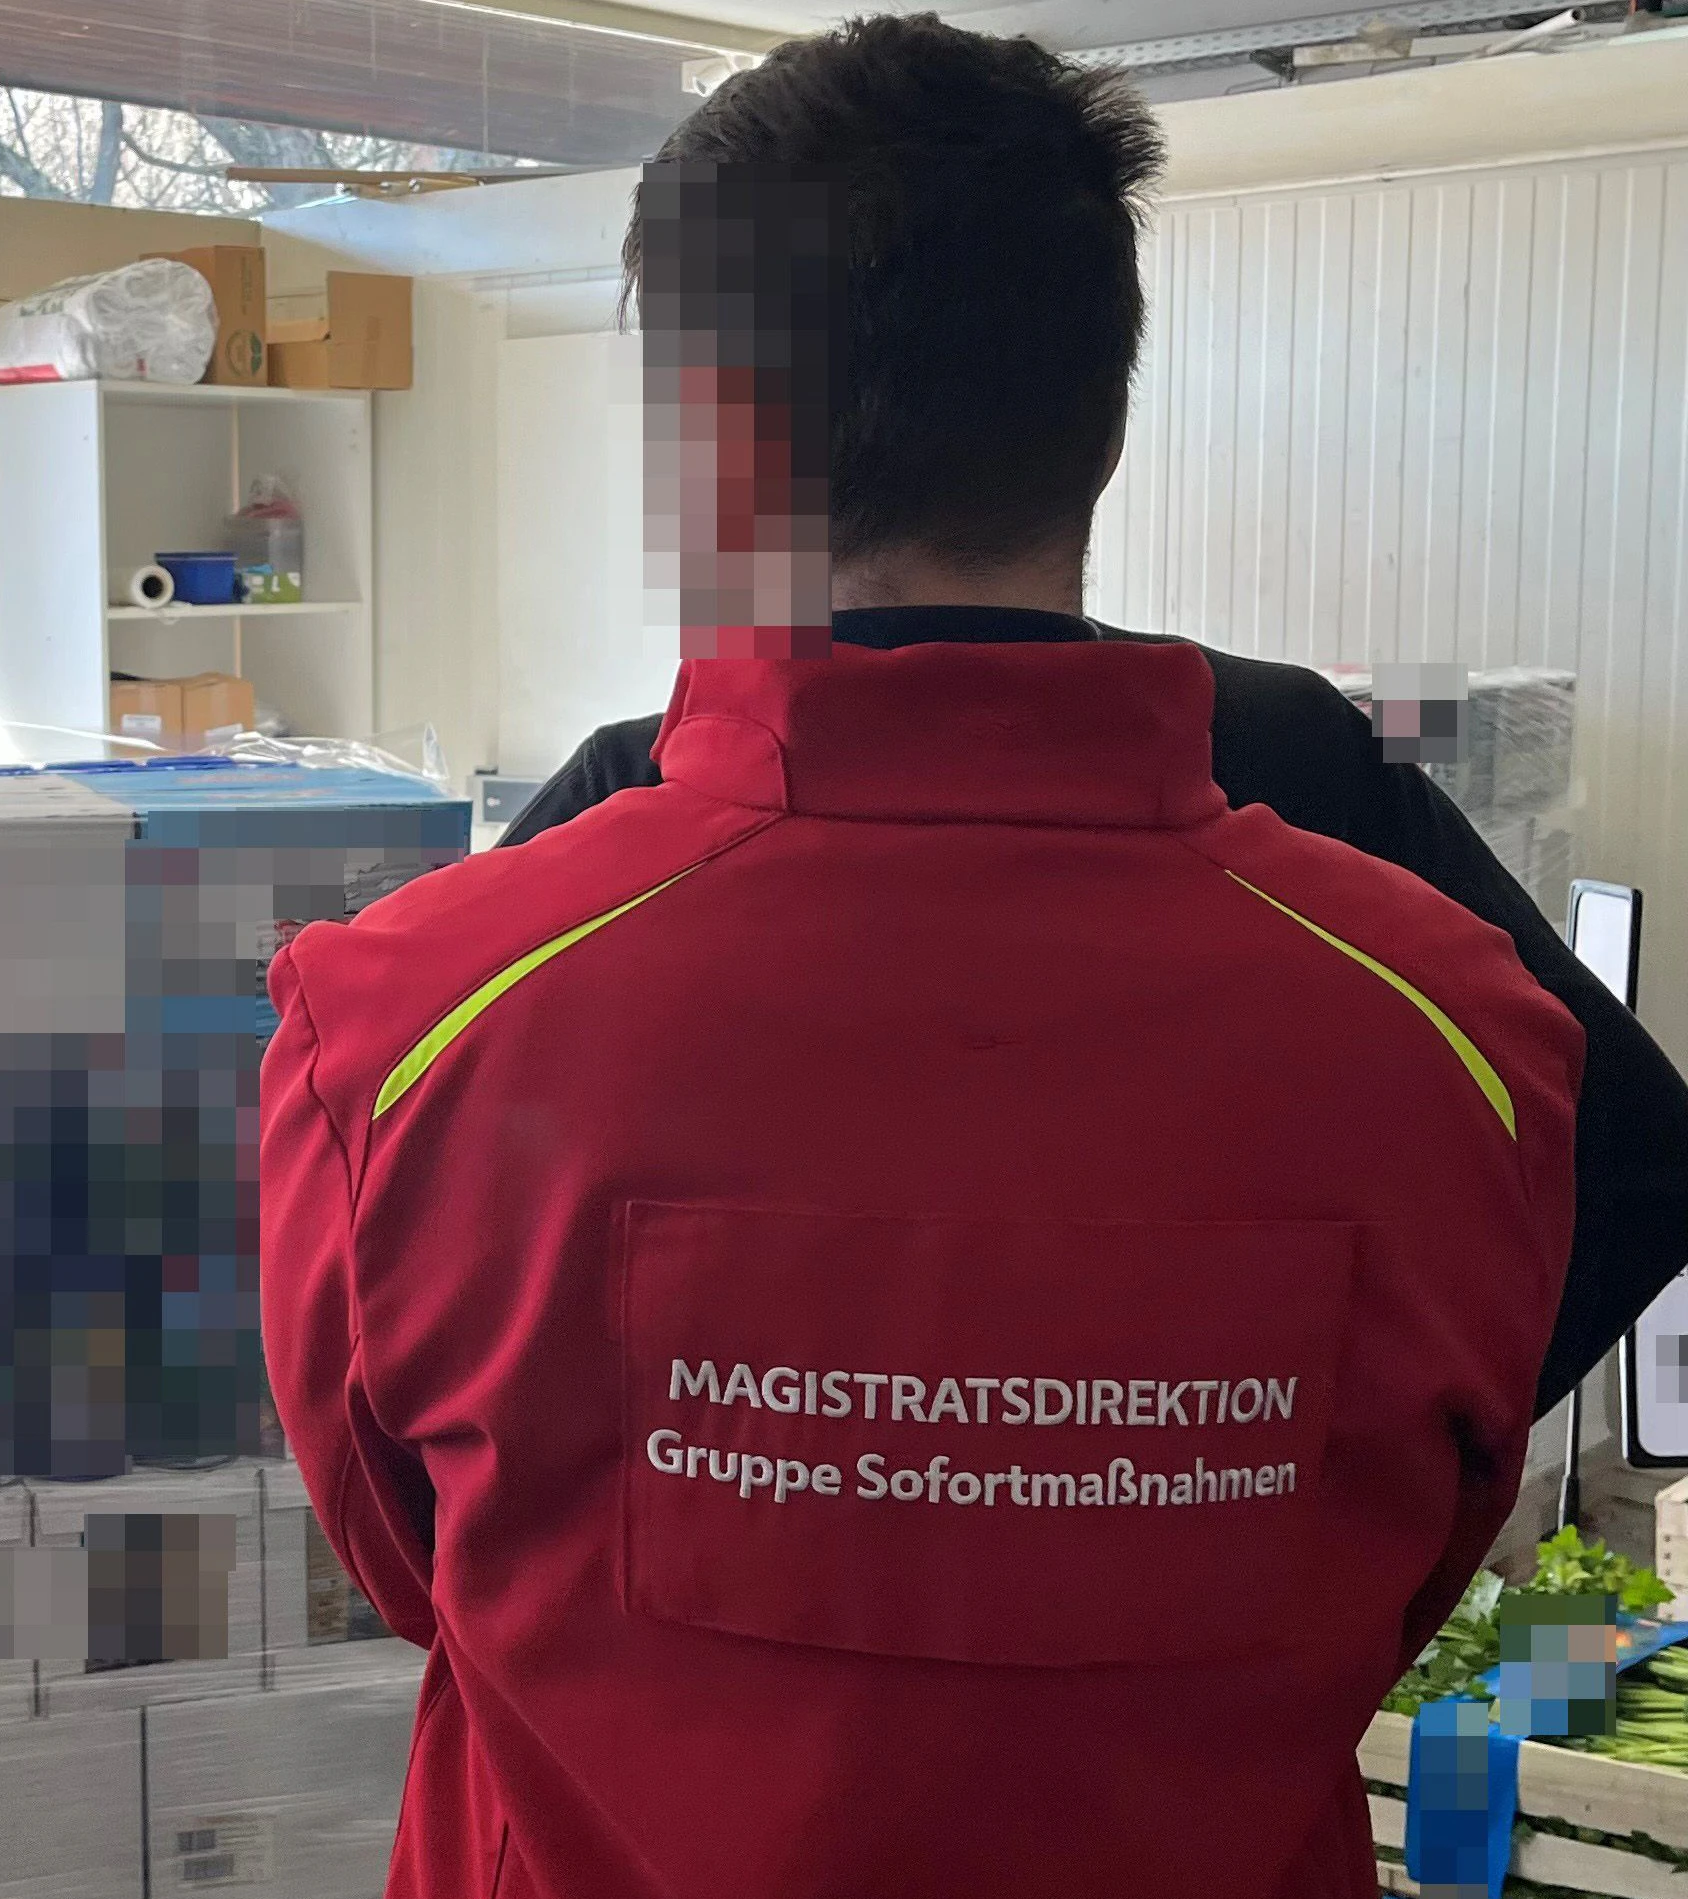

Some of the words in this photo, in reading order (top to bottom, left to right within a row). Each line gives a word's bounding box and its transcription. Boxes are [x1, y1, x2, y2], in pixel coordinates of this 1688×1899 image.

[669, 1358, 1299, 1426] MAGISTRATSDIREKTION
[646, 1428, 843, 1504] Gruppe
[856, 1453, 1297, 1507] Sofortmaßnahmen
